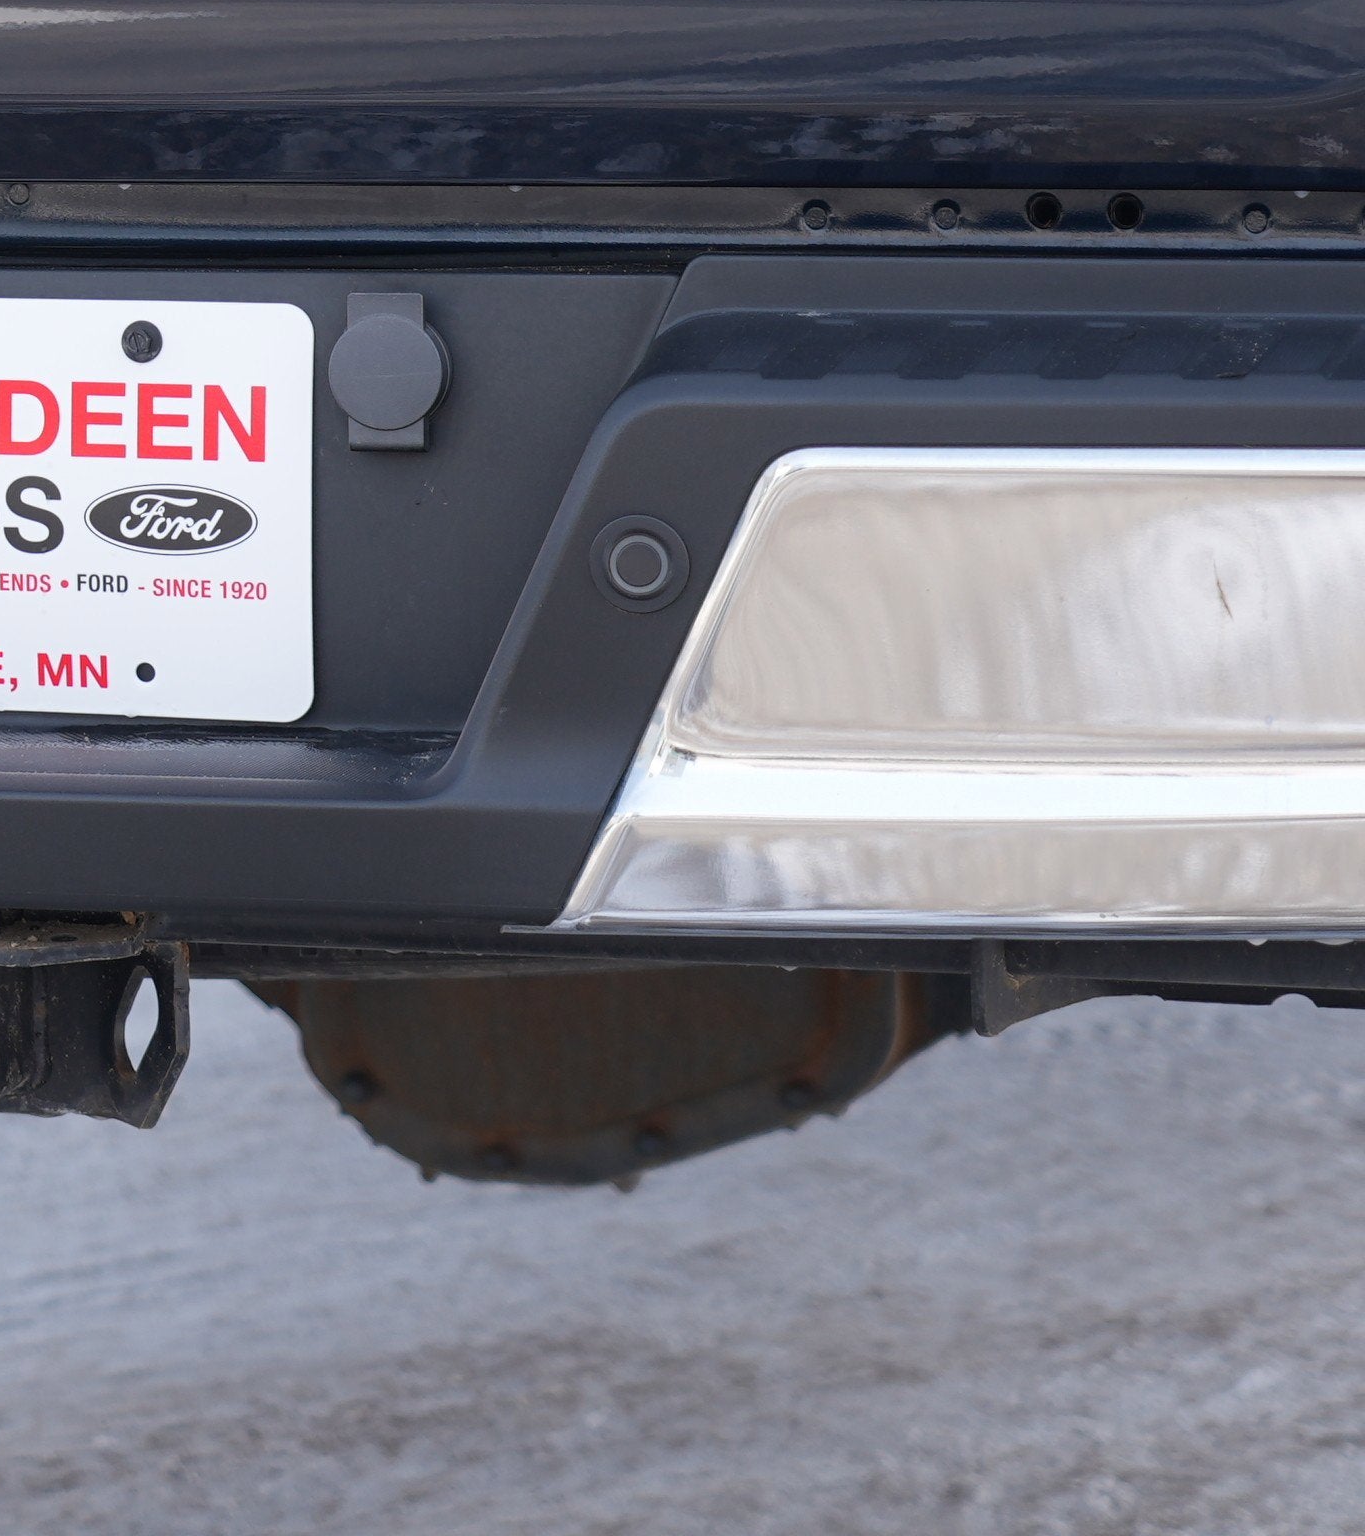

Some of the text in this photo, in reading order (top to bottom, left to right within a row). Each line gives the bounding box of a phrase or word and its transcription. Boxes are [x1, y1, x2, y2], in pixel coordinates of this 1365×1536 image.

[120, 492, 224, 543] Ford
[76, 574, 129, 593] FORD
[153, 578, 212, 598] SINCE
[219, 580, 267, 600] 1920
[37, 652, 109, 689] MN
